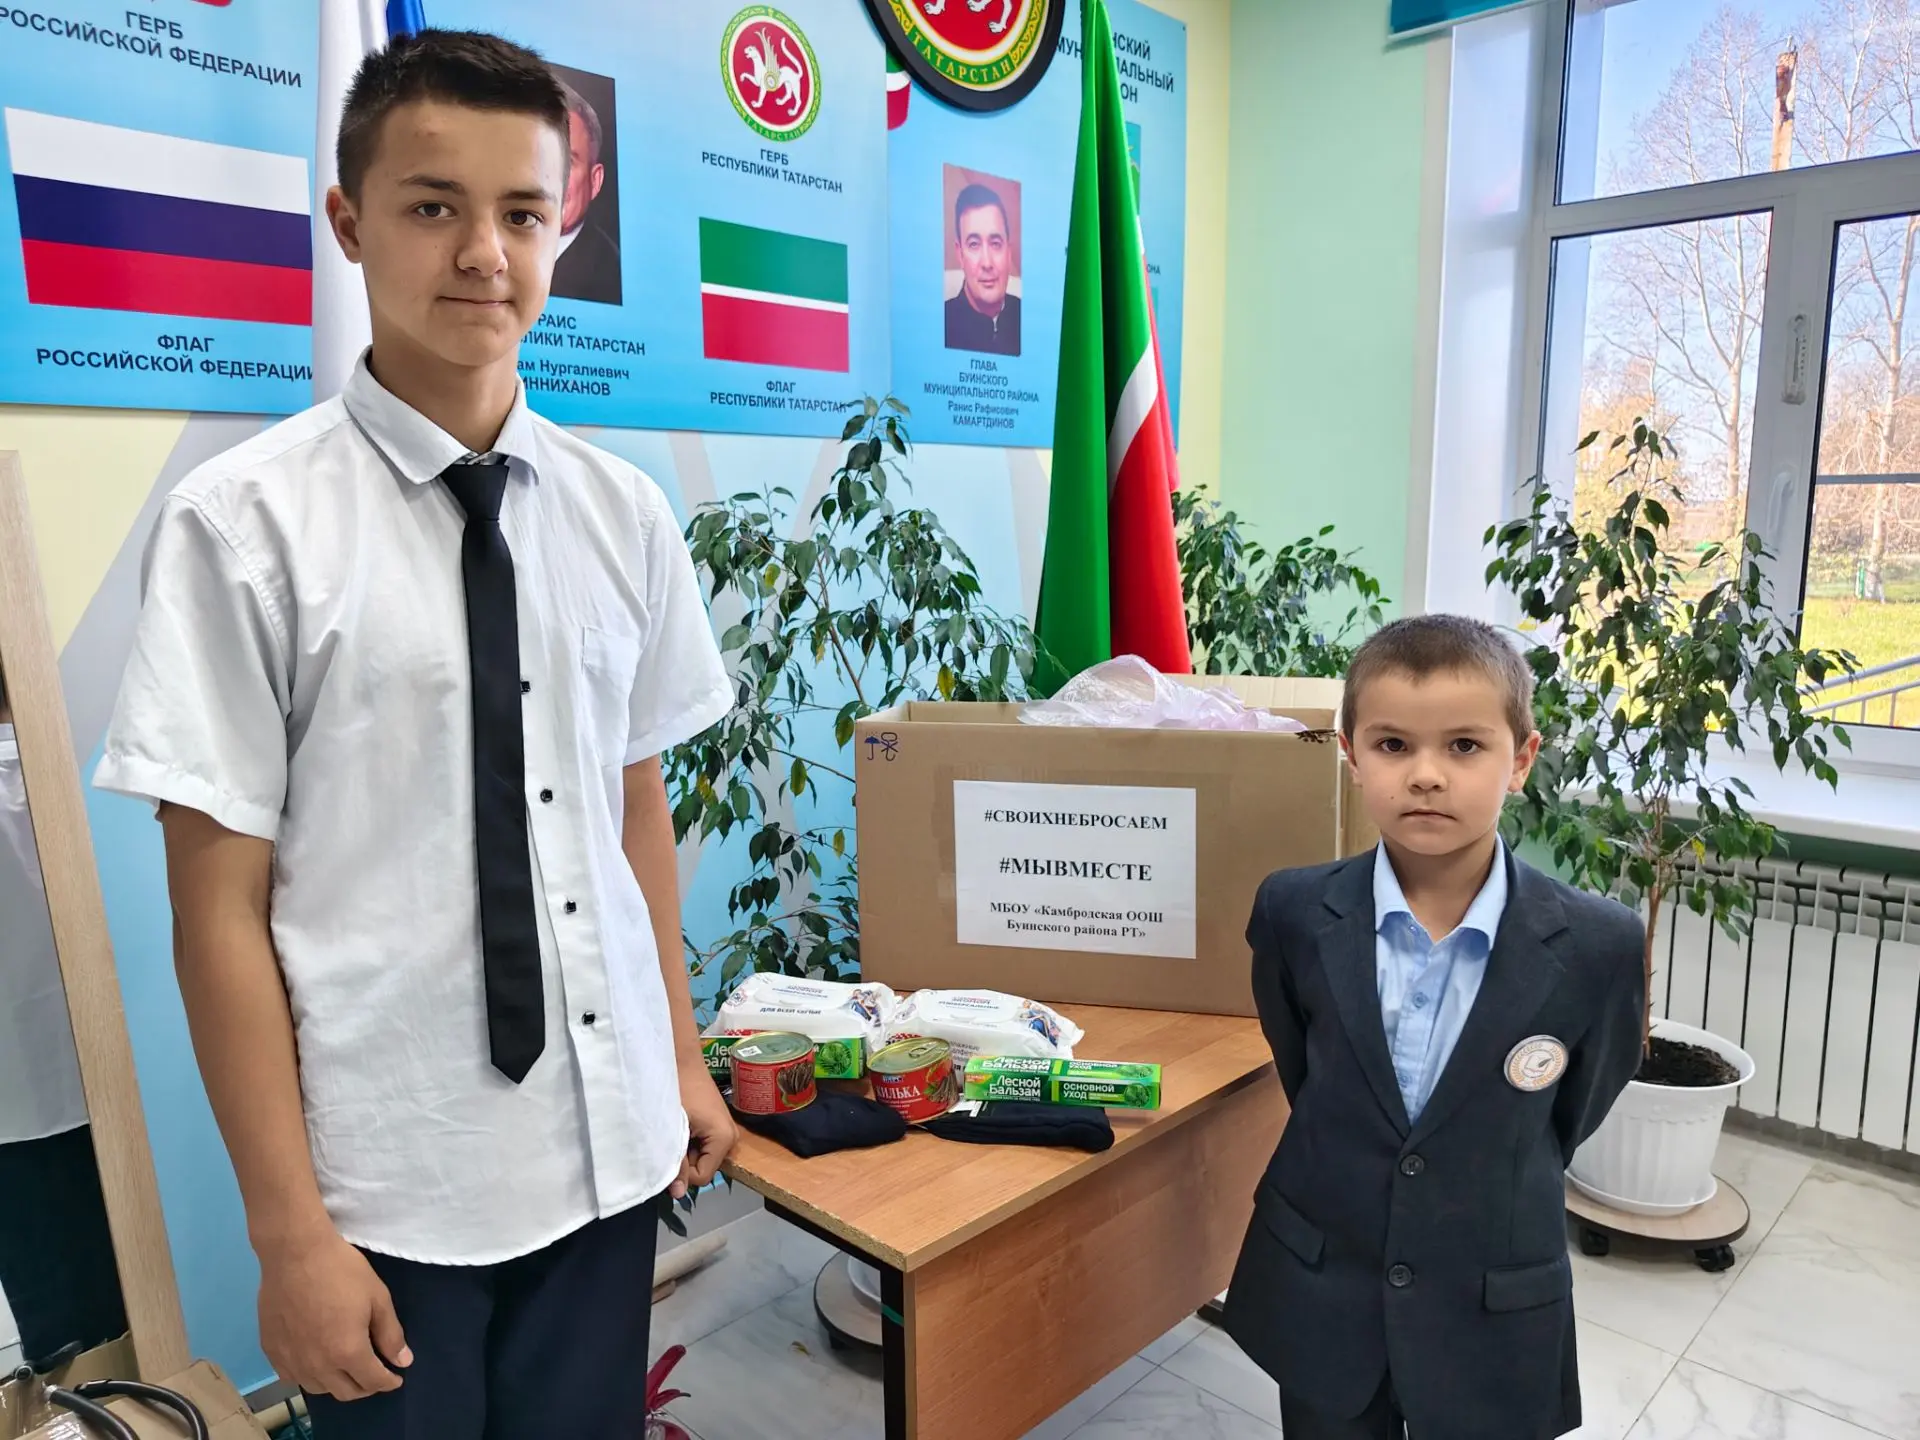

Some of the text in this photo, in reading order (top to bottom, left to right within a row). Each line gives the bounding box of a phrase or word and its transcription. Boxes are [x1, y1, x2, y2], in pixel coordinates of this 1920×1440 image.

[125, 10, 184, 40] ГЕРБ
[169, 46, 303, 88] ФЕДЕРАЦИИ
[912, 31, 1011, 83] ТАТАРСТАН
[760, 148, 789, 166] ГЕРБ
[701, 151, 843, 194] РЕСПУБЛИКИ ТАТАРСТАН
[538, 313, 577, 330] РАИС
[157, 334, 215, 353] ФЛАГ
[567, 334, 646, 356] ТАТАРСТАН
[36, 348, 193, 374] РОССИЙСКОЙ
[539, 359, 630, 380] Нургалиевич
[970, 359, 998, 372] ГЛАВА
[523, 376, 612, 396] ИННИХАНОВ
[766, 380, 796, 394] ФЛАГ
[959, 372, 1009, 387] БУИНСКОГО
[923, 382, 1040, 402] МУНИЦИПАЛЬНОГО РАЙОНА
[710, 391, 847, 414] РЕСПУБЛИКИ ТАТАРСТАН
[948, 400, 1019, 416] Ранис Рафисович
[952, 414, 1016, 429] КАМАРТДИНОВ
[984, 809, 1168, 830] #СВОИХНЕБРОСАЕМ
[999, 857, 1153, 882] #МЫВМЕСТЕ
[989, 901, 1164, 923] МБОУ «Камбродская ООШ
[1006, 918, 1146, 938] Буинского района РТ»
[989, 1084, 1041, 1097] Бальзам
[996, 1075, 1041, 1088] Лесной
[1063, 1082, 1115, 1093] ОСНОВНОЙ
[1063, 1091, 1088, 1100] УХОД
